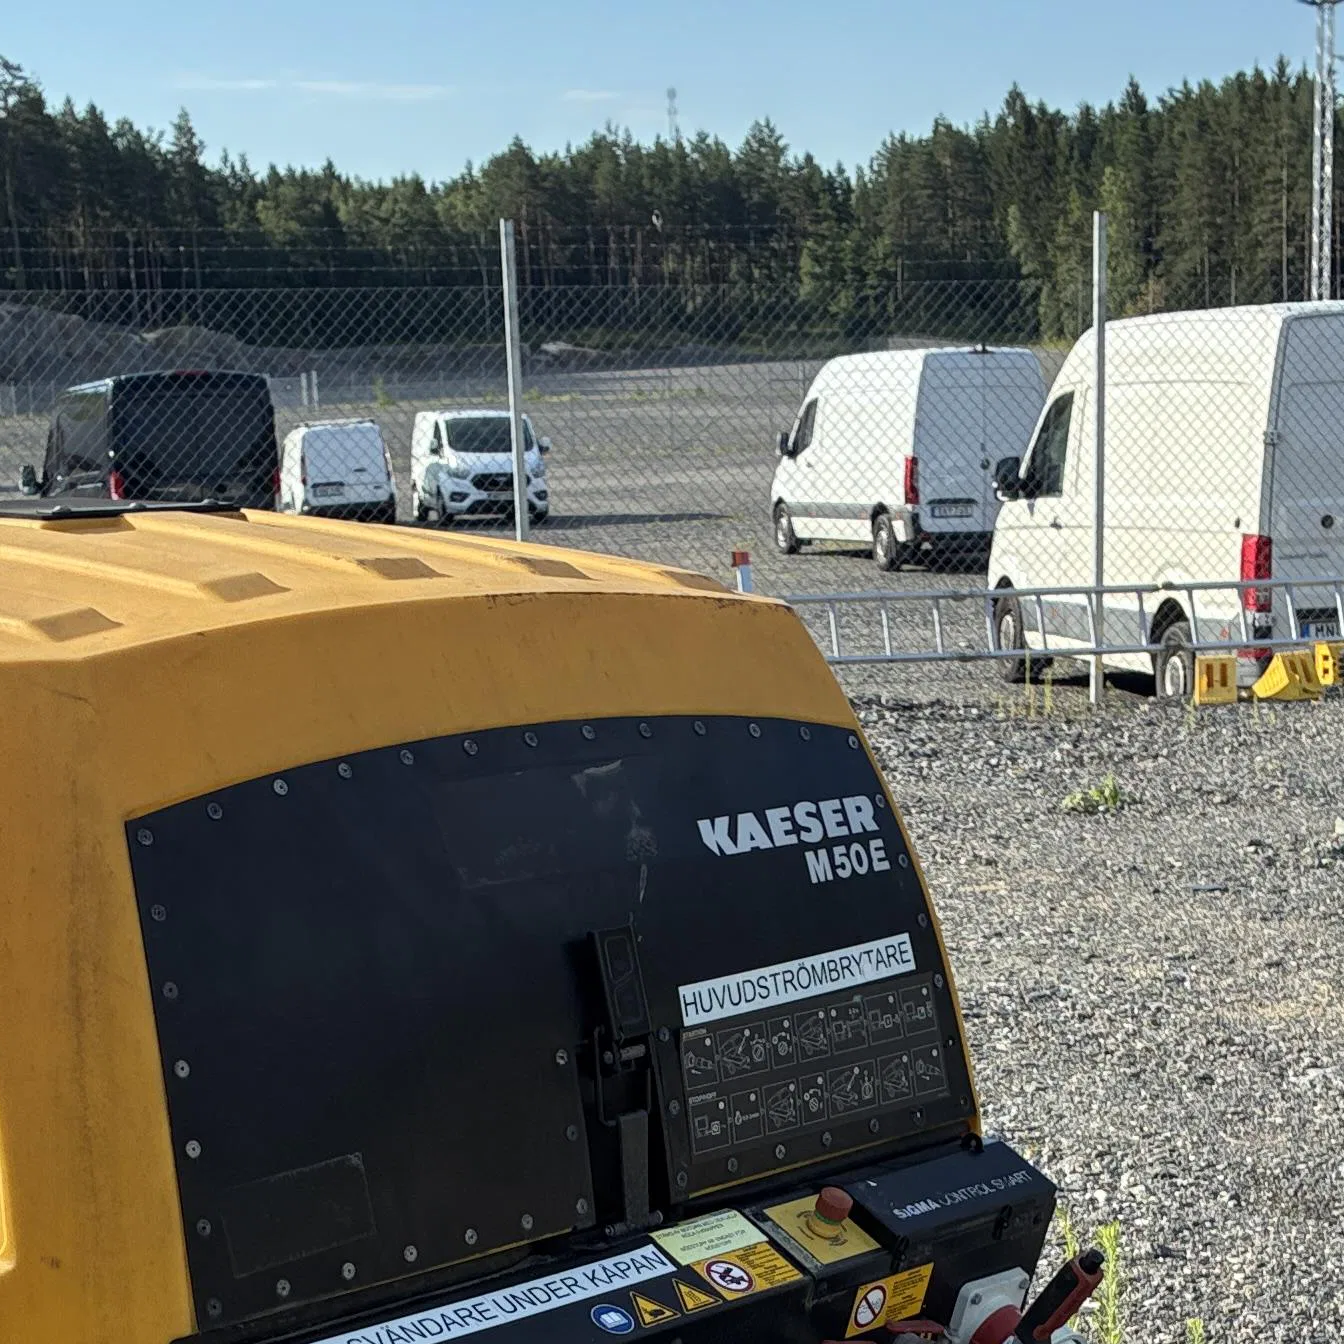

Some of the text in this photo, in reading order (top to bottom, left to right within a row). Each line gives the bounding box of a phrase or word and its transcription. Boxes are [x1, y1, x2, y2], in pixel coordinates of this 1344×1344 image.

[696, 795, 880, 856] KAESER
[682, 941, 912, 1018] HUVUDSTRÖMBRYTARE
[495, 1276, 586, 1314] UNDER
[588, 1250, 669, 1288] KÅPAN
